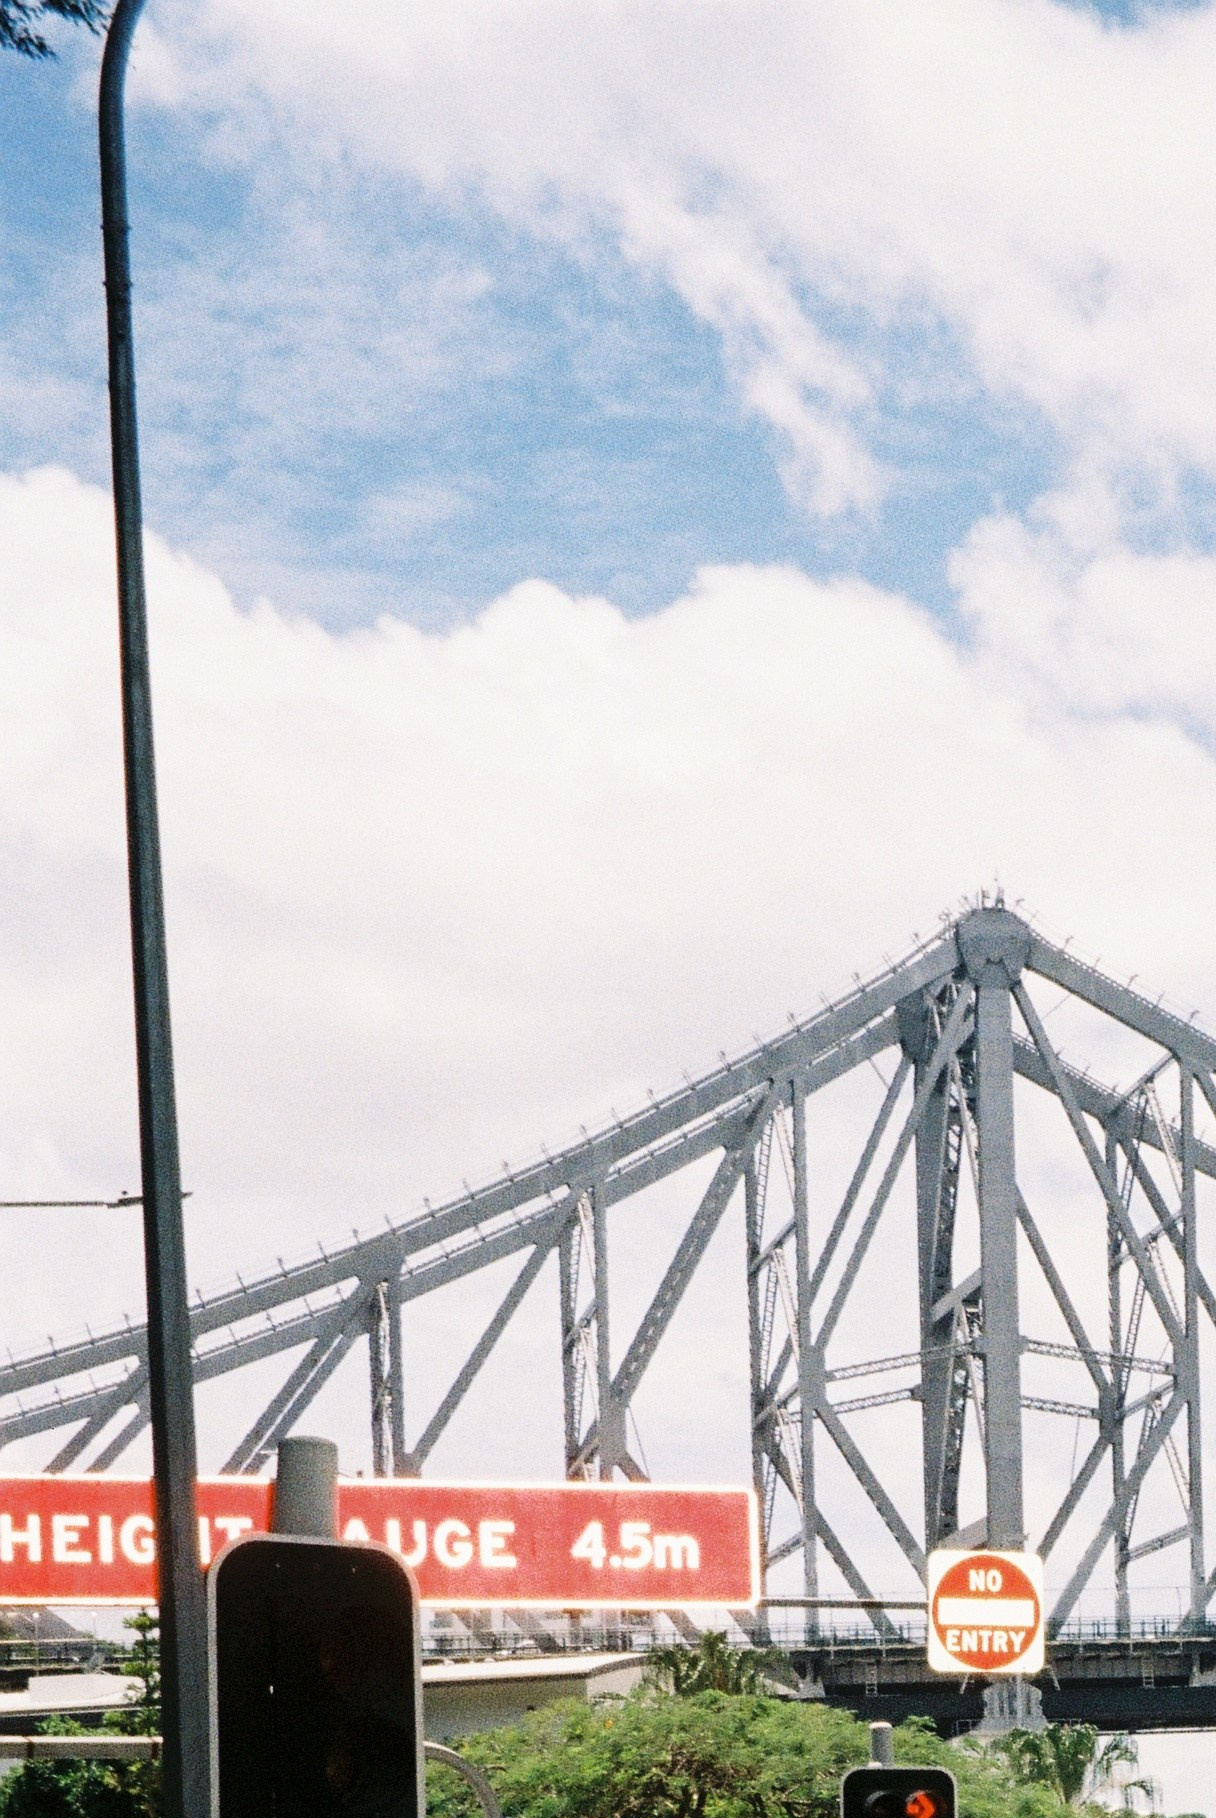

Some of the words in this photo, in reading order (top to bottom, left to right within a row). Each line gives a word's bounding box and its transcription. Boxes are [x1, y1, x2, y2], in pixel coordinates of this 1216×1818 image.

[571, 1521, 700, 1569] 4.5m
[968, 1569, 1003, 1592] NO
[946, 1629, 1026, 1653] ENTRY
